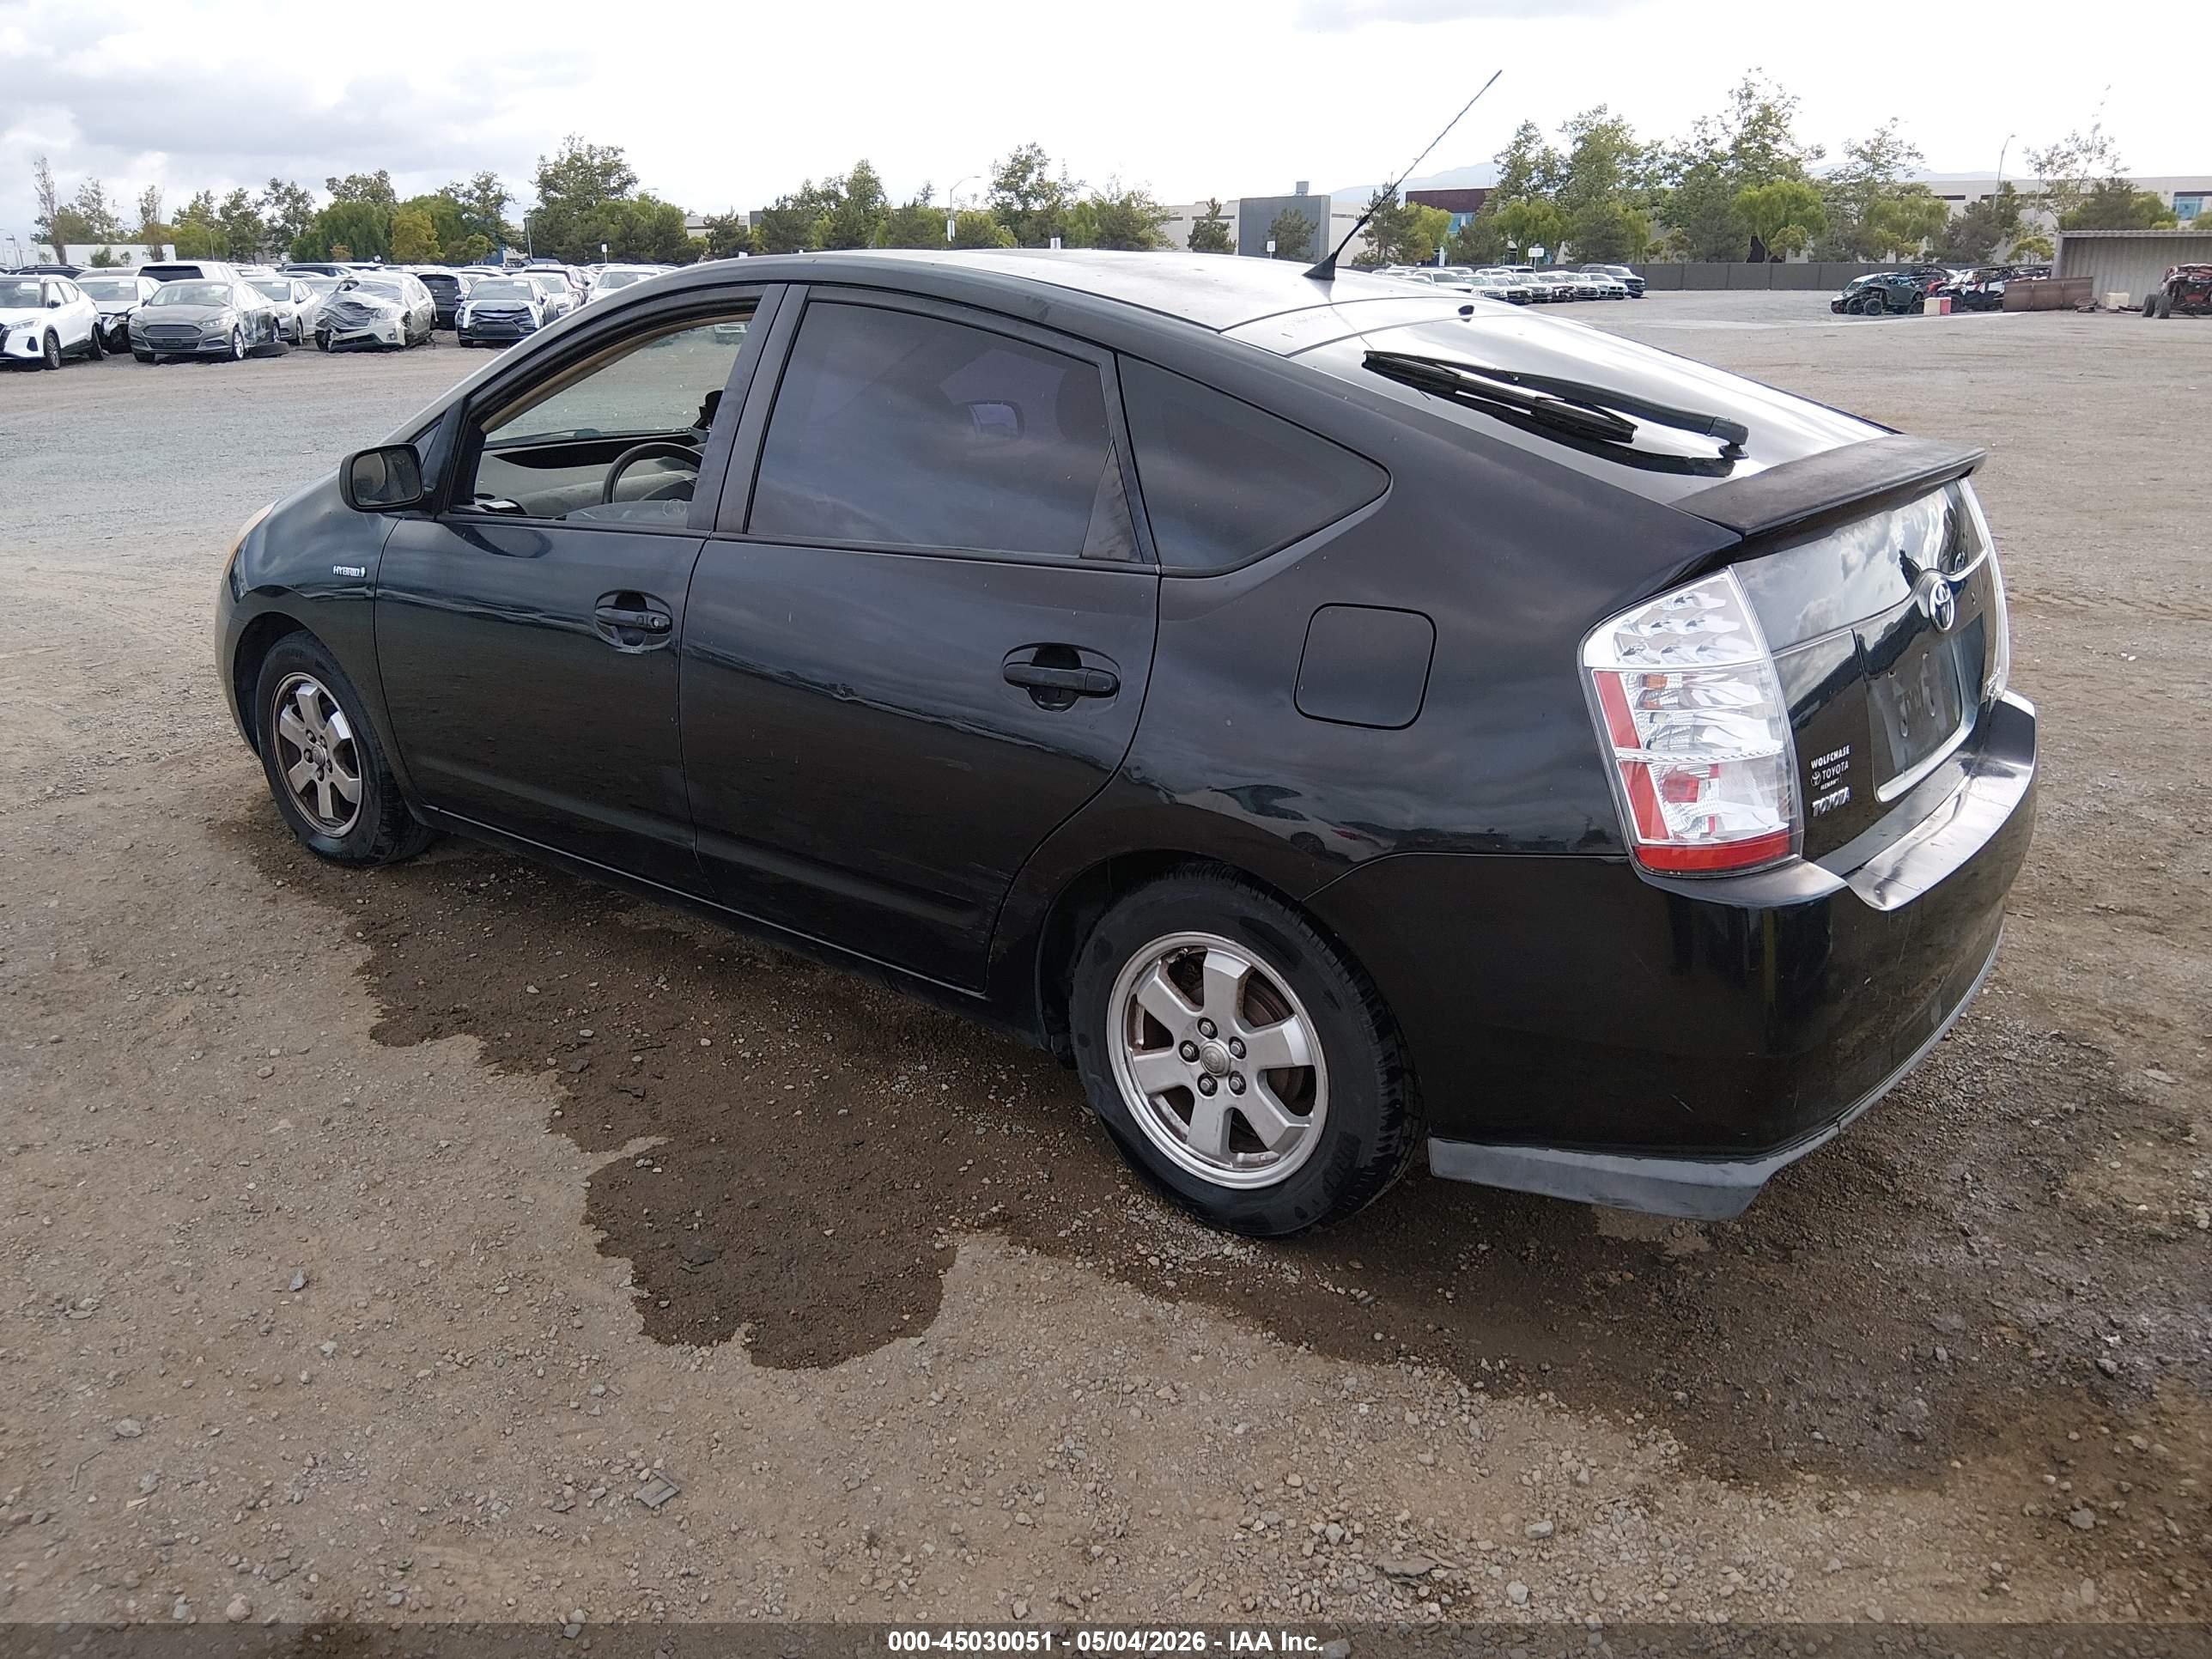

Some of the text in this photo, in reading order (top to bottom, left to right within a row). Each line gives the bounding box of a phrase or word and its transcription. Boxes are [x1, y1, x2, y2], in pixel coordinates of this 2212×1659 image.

[333, 565, 360, 577] HYBRID
[1810, 744, 1850, 769] WOLFCHASE
[1821, 760, 1849, 781] TOYOTA
[1812, 786, 1851, 817] TOYOTA
